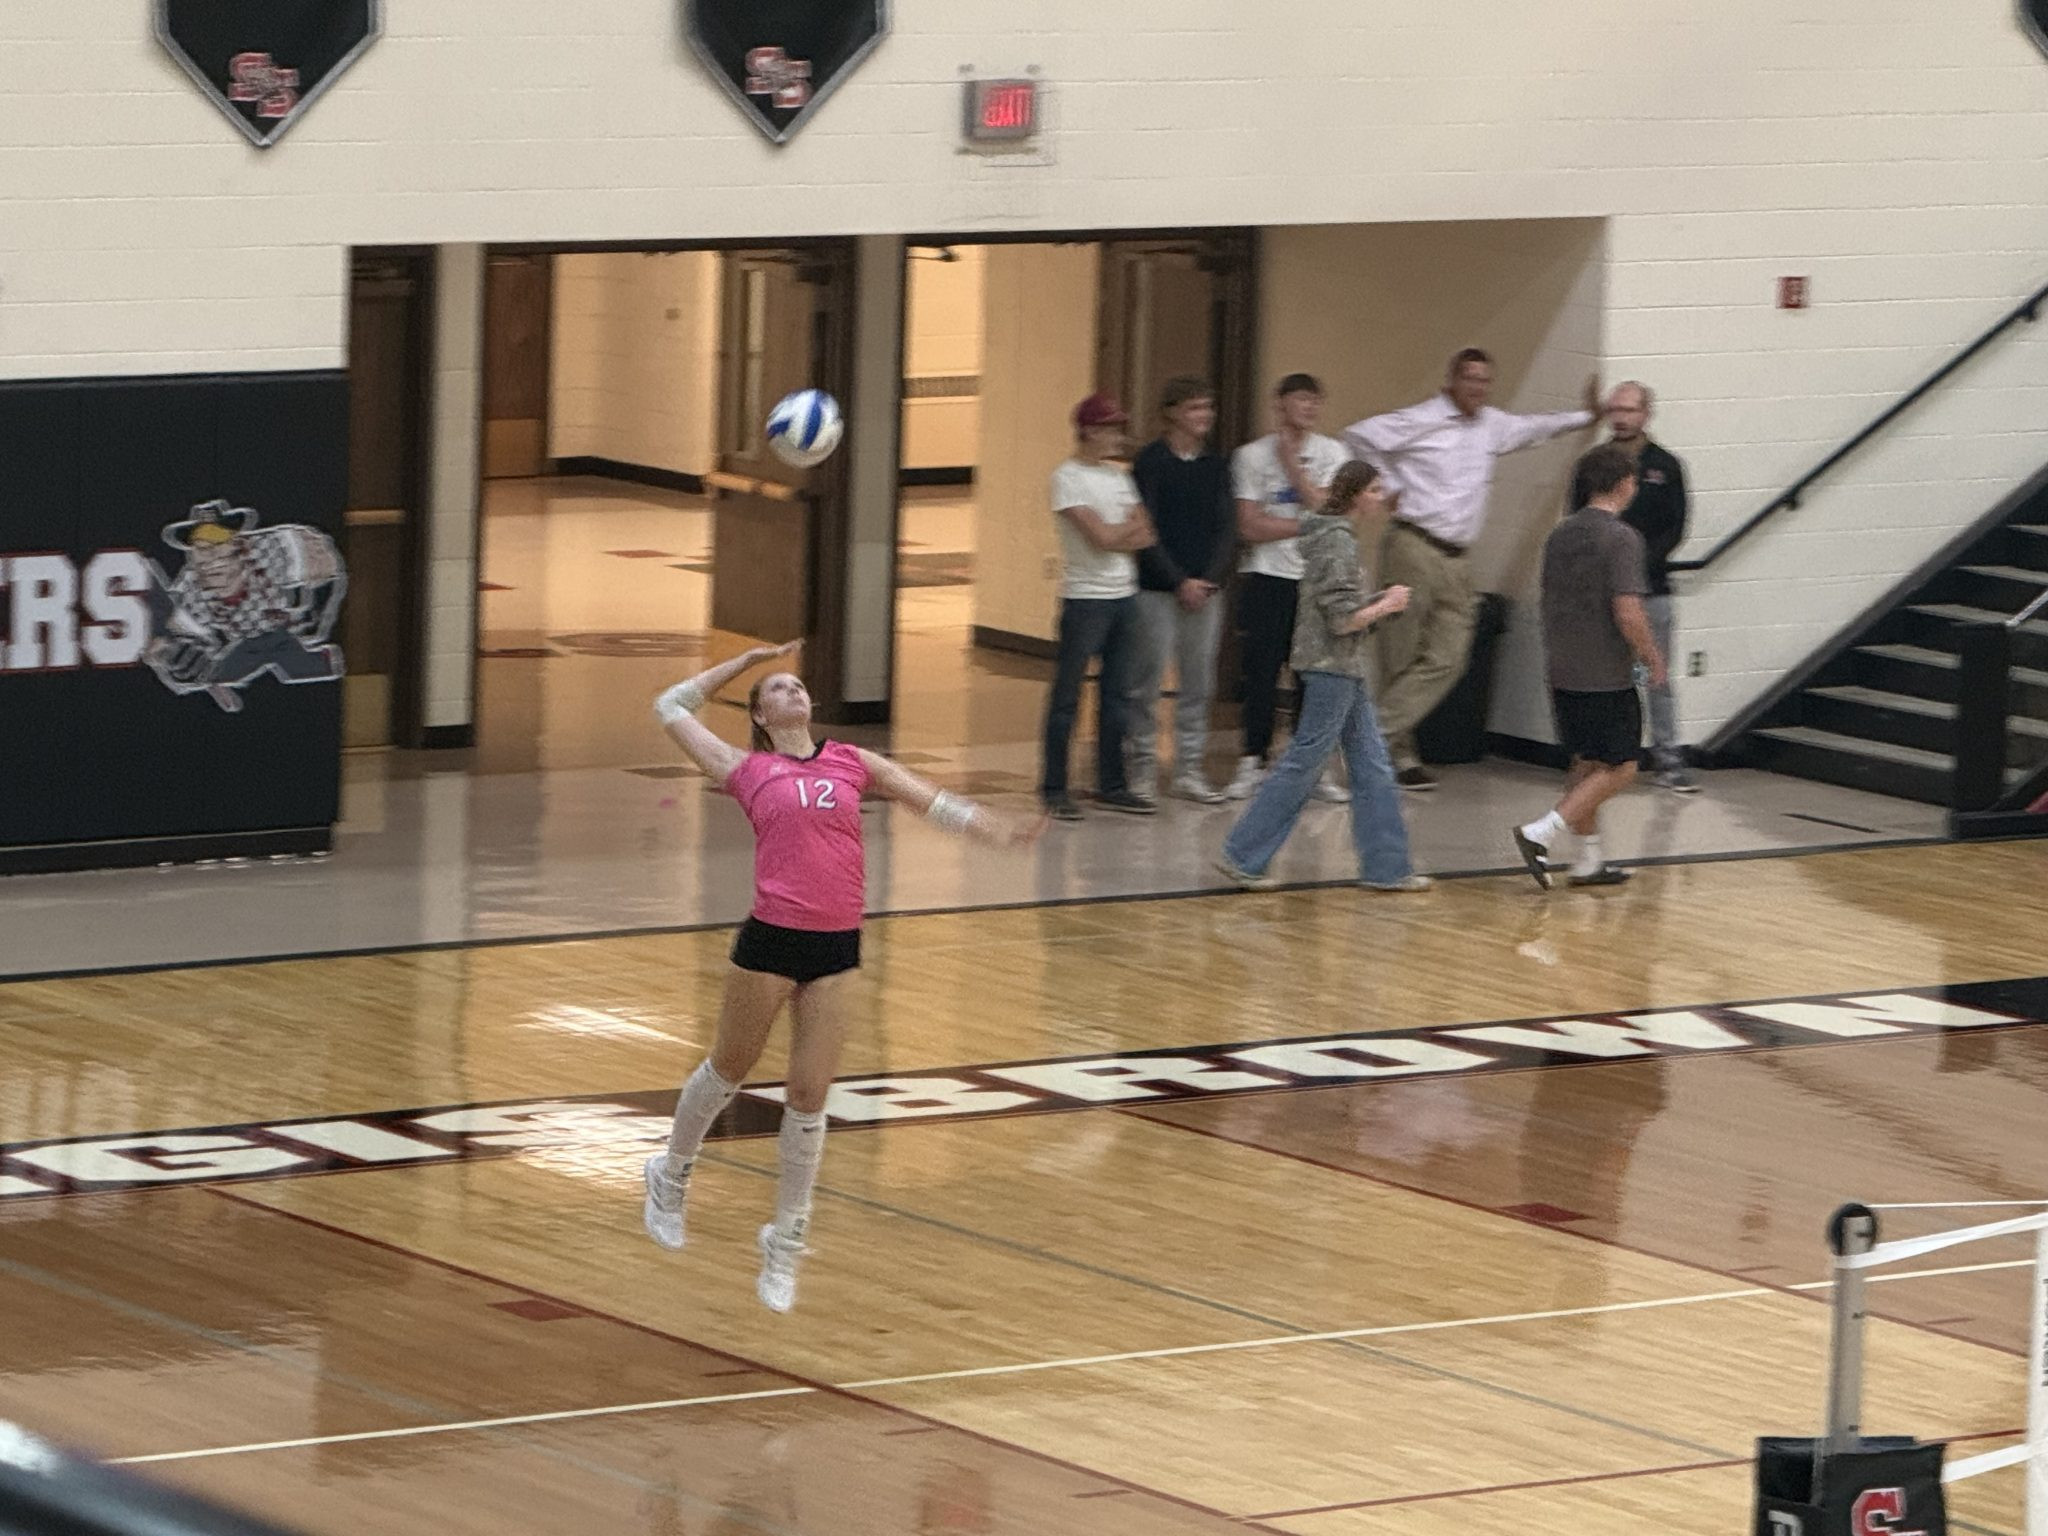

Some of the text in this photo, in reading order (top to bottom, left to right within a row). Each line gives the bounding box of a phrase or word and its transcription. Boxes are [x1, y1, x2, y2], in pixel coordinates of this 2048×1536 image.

[0, 550, 150, 674] RS
[795, 779, 837, 809] 12
[0, 993, 2026, 1195] GIS BROWN
